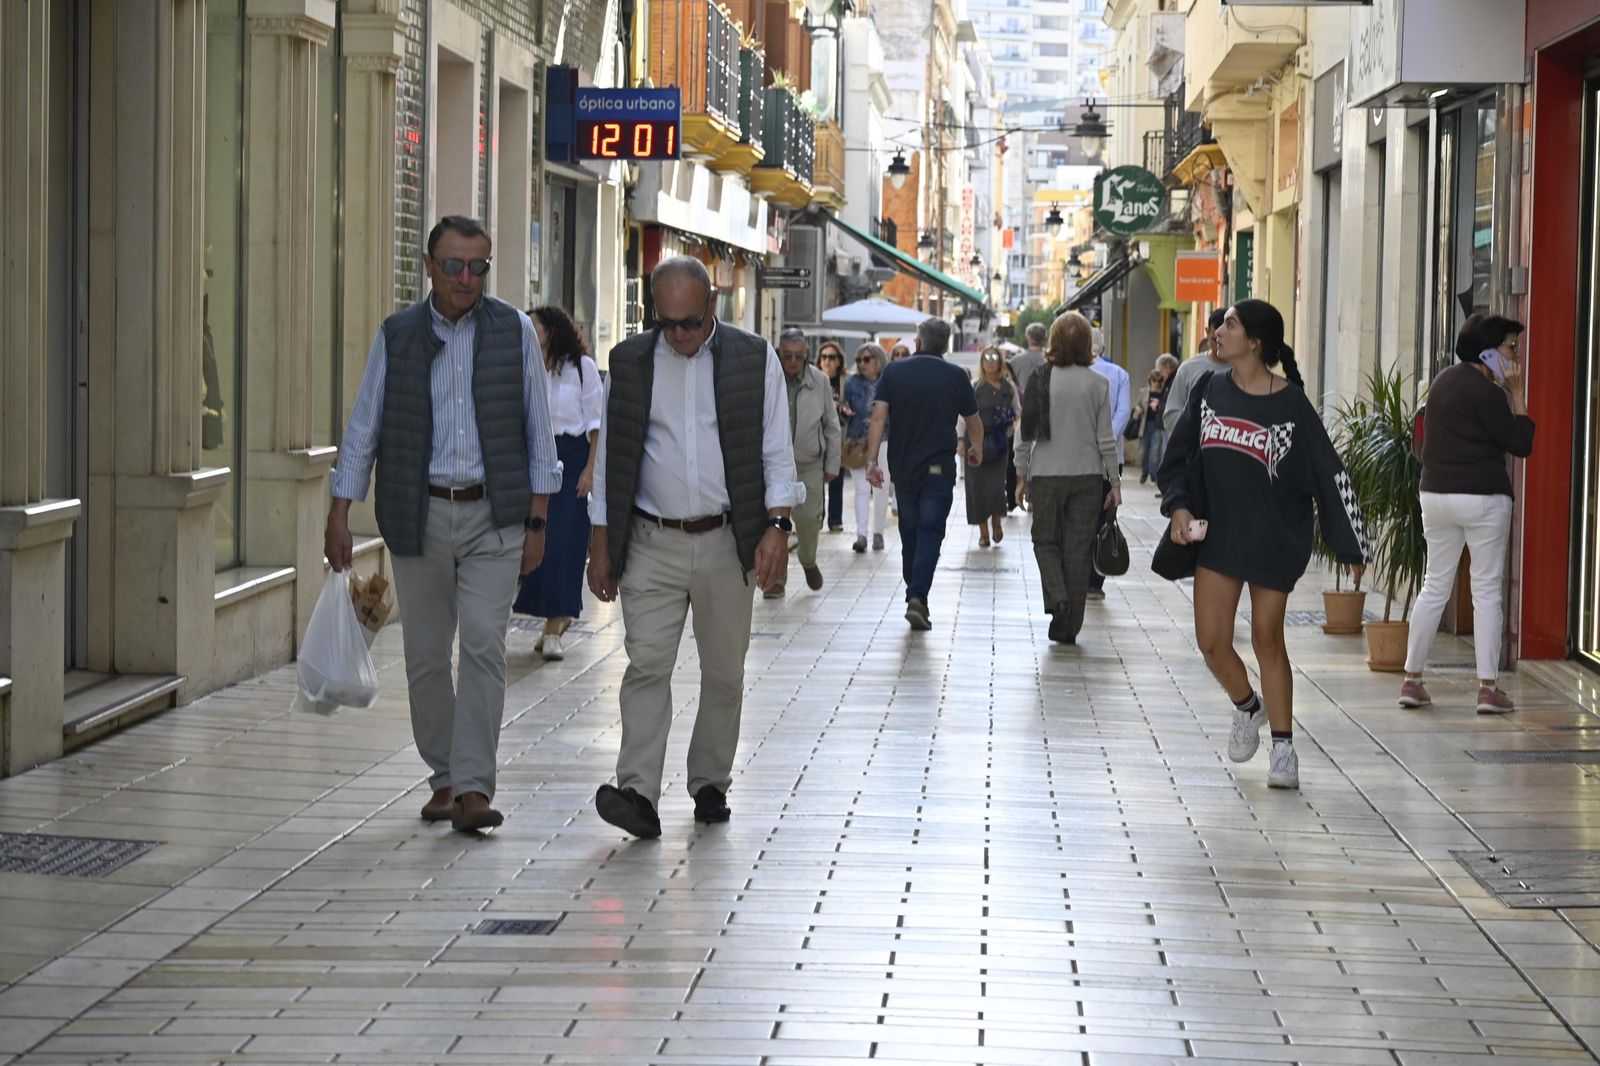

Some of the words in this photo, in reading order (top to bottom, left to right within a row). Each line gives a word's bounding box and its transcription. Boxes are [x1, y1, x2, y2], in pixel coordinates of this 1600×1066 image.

[579, 95, 623, 112] óptica
[626, 96, 675, 110] urbano
[1200, 416, 1274, 460] METALLICA
